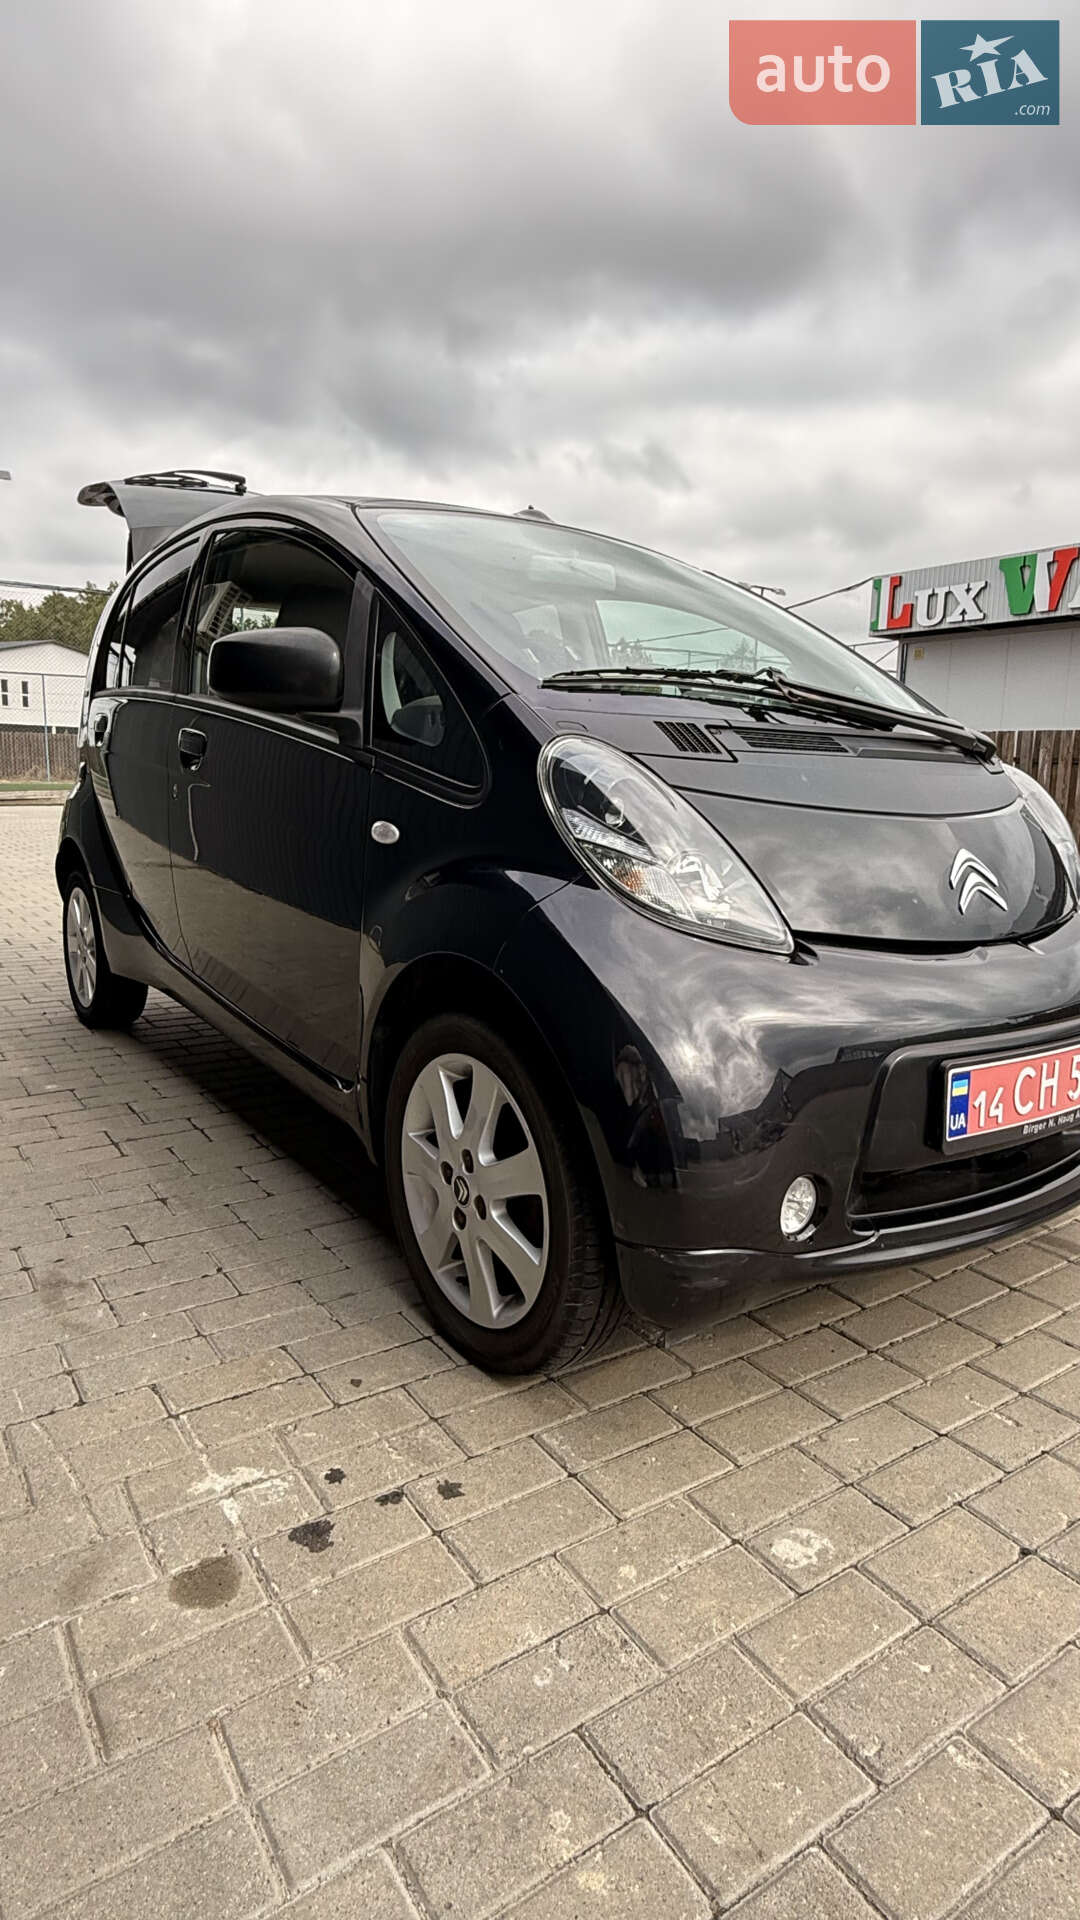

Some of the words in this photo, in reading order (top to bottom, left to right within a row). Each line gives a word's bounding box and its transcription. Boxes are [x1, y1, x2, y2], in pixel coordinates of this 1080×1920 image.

[972, 1087, 1005, 1128] 14
[1013, 1059, 1060, 1116] CH
[950, 1112, 966, 1131] UA
